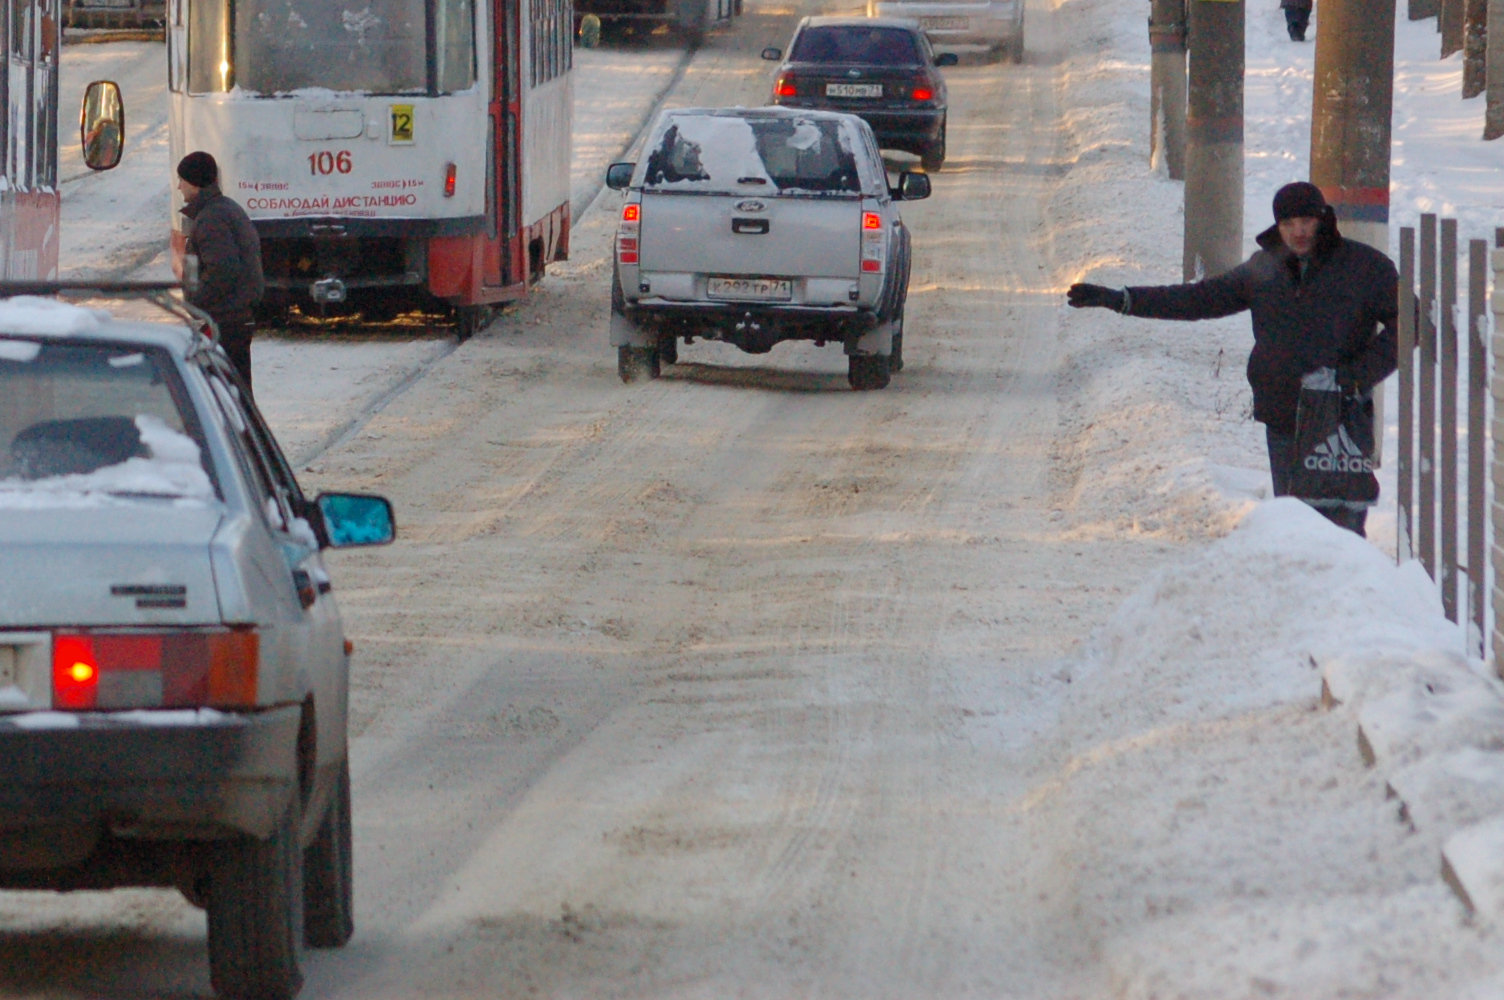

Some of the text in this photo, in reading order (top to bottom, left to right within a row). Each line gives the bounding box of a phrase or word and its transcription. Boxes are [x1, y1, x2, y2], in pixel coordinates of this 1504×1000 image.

[392, 113, 411, 136] 12
[308, 150, 352, 176] 106
[247, 194, 417, 210] СОБЛЮДАЙ ДИСТАНЦИЮ
[1304, 452, 1374, 473] adidas
